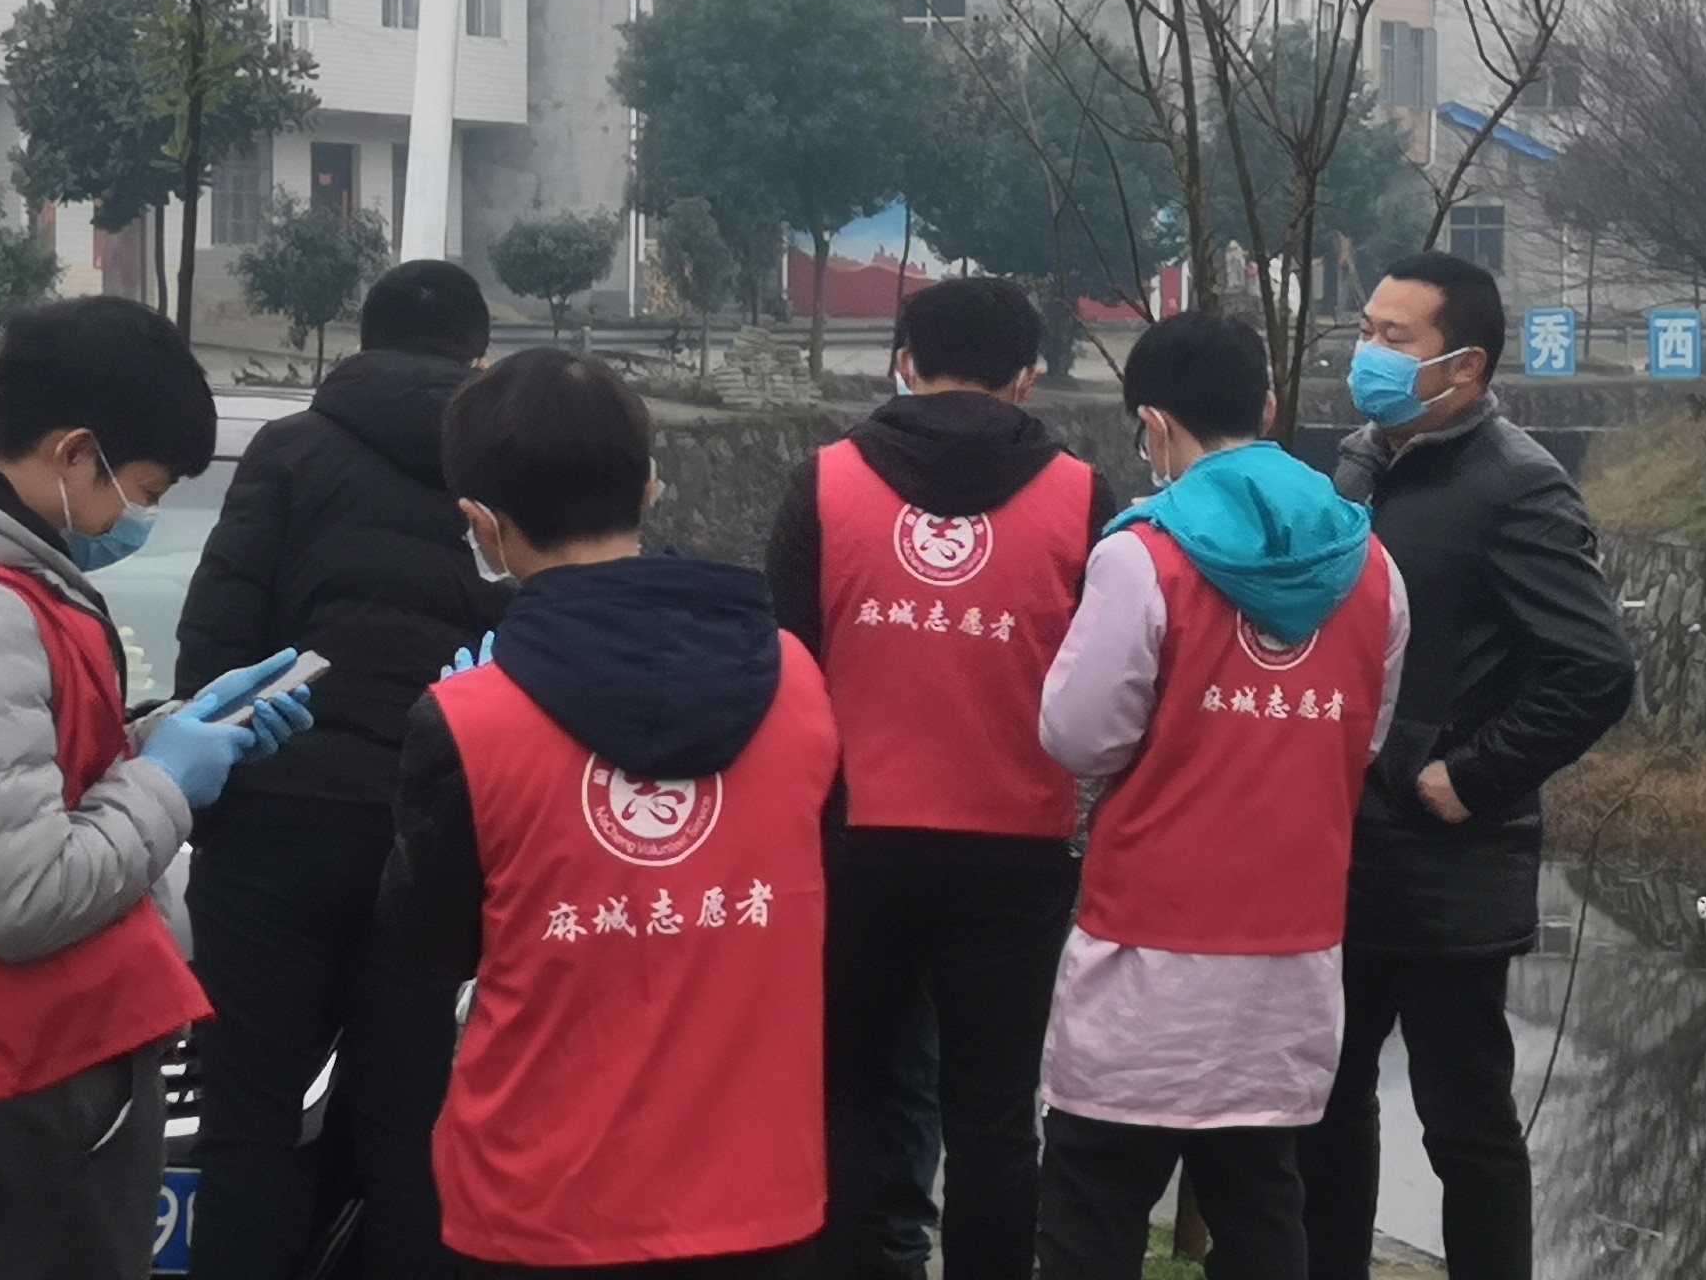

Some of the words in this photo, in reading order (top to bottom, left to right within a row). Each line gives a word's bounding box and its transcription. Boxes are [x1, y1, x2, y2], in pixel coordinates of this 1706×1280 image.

[1530, 314, 1571, 369] 秀
[854, 598, 1016, 642] 麻城志愿者
[1199, 684, 1344, 721] 麻城志愿者
[541, 878, 774, 942] 麻城志愿者
